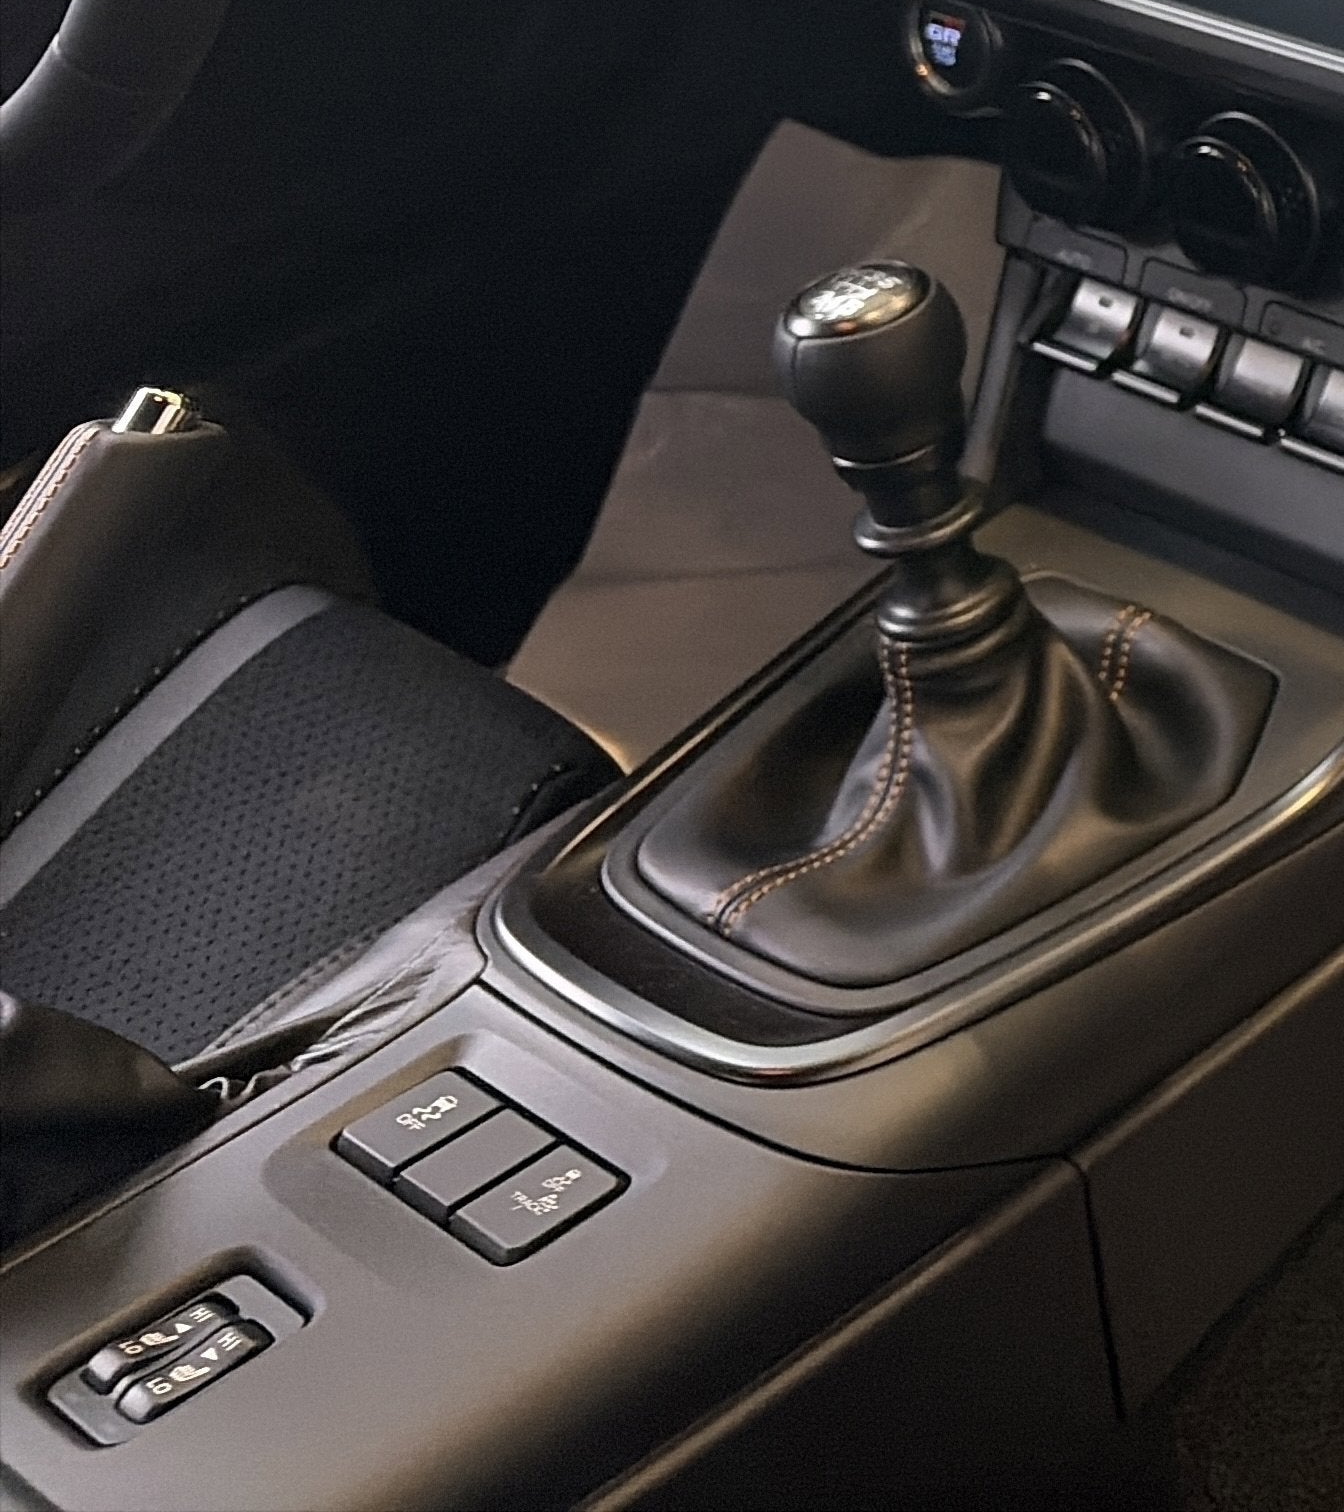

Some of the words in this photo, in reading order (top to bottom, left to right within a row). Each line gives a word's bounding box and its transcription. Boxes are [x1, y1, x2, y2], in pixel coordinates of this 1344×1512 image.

[396, 1113, 426, 1130] OFF
[511, 1191, 543, 1216] TRACK
[189, 1307, 216, 1323] HI
[118, 1340, 144, 1355] LO
[217, 1332, 243, 1352] HI
[145, 1376, 173, 1395] LO
